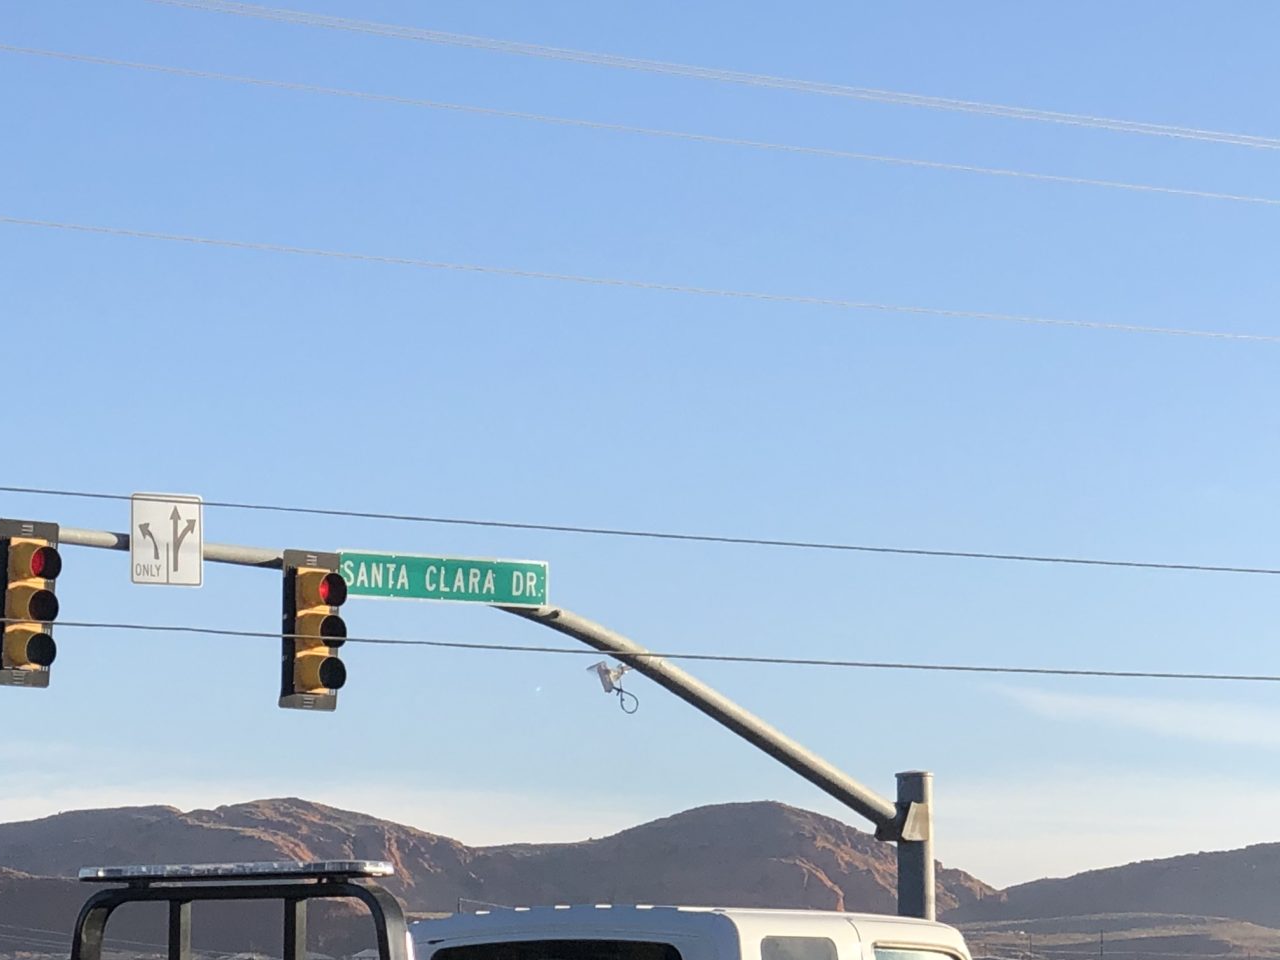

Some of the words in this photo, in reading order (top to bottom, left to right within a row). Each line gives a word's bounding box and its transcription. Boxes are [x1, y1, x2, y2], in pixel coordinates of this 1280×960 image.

[135, 563, 162, 578] ONLY
[343, 560, 410, 591] SANTA
[425, 565, 495, 594] CLARA
